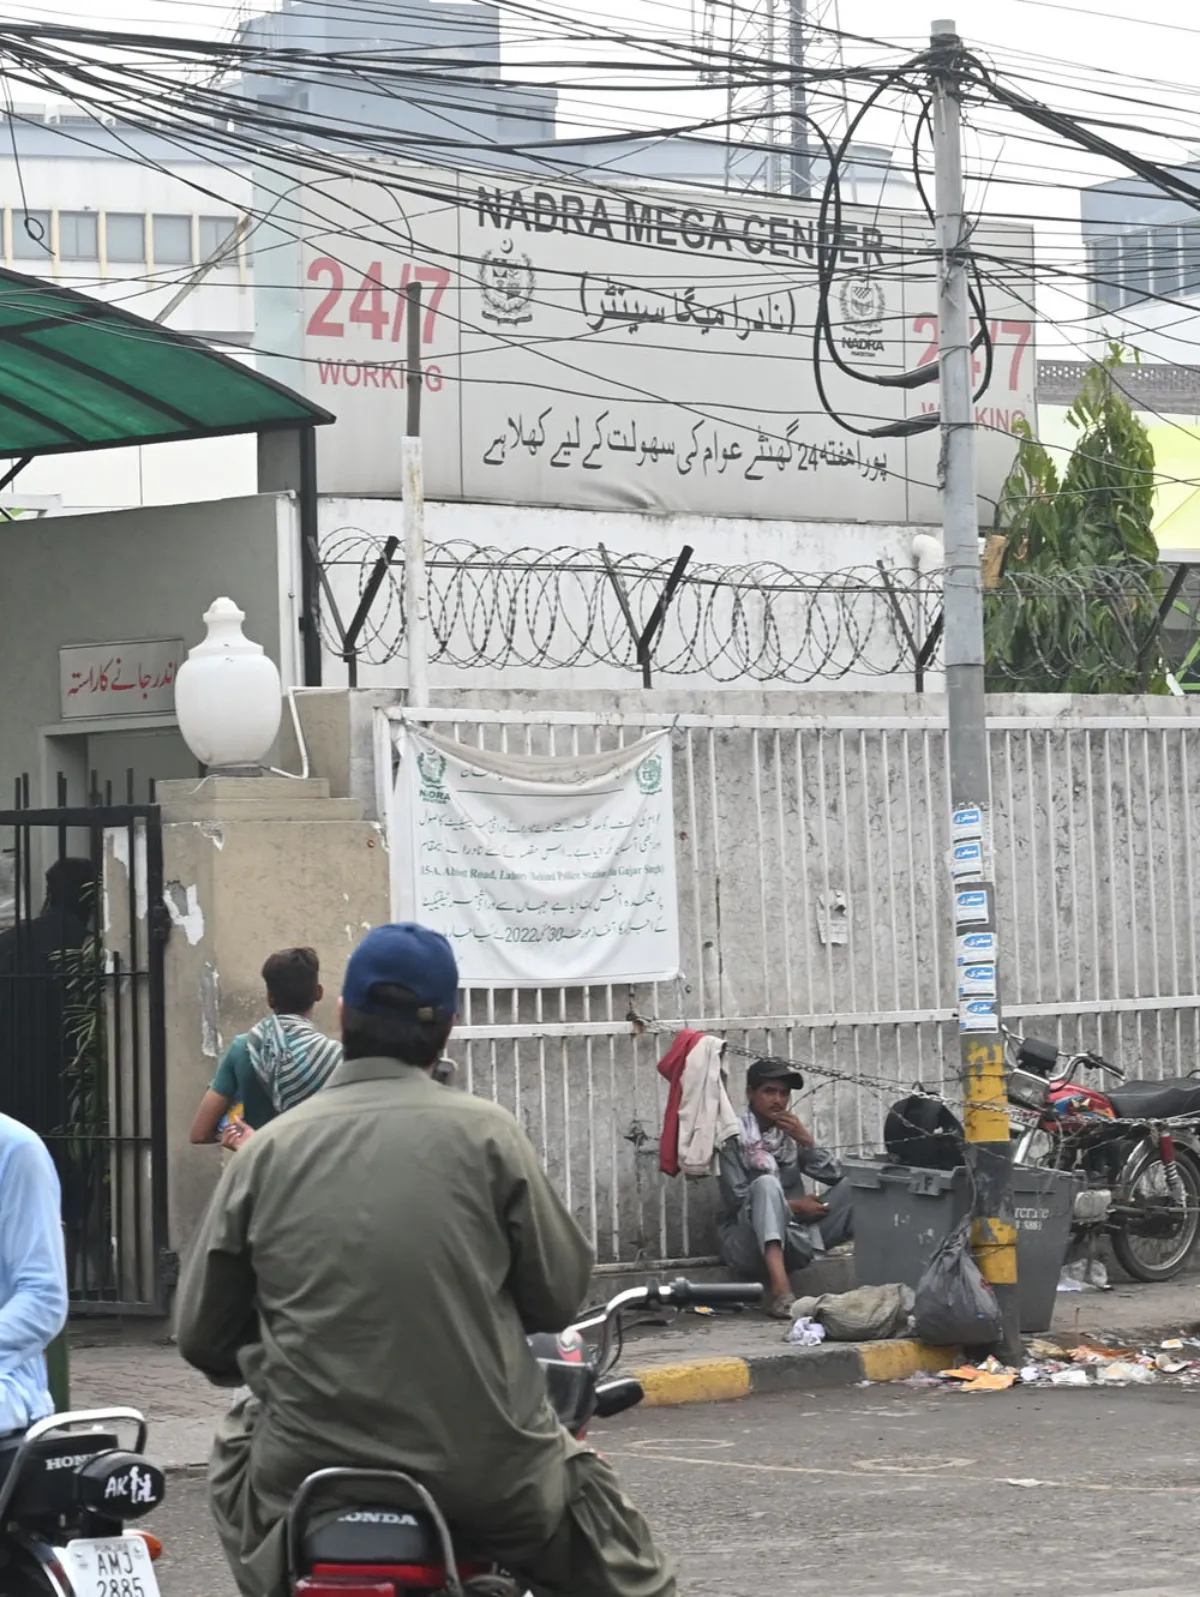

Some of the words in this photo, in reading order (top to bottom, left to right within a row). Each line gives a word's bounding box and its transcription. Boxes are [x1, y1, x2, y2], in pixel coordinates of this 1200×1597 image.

[477, 185, 614, 240] NADRA
[624, 200, 733, 251] MEGA
[306, 256, 452, 344] 24/7
[842, 337, 885, 352] NADRA
[317, 357, 443, 392] WORKIG
[508, 406, 553, 456] کھلا
[582, 410, 610, 470] کے
[607, 419, 676, 467] سہولت
[677, 410, 705, 476] کی
[483, 433, 507, 466] ہے
[702, 430, 743, 478] عوام
[744, 418, 799, 481] گھنٹے
[797, 442, 819, 472] 24
[67, 661, 100, 697] راستہ
[99, 656, 116, 692] کا
[110, 657, 153, 700] جانے
[505, 926, 538, 943] 2022
[44, 1453, 92, 1471] HON
[337, 1511, 418, 1526] ONDA
[98, 1551, 134, 1577] AMJ
[96, 1576, 145, 1597] 2885
